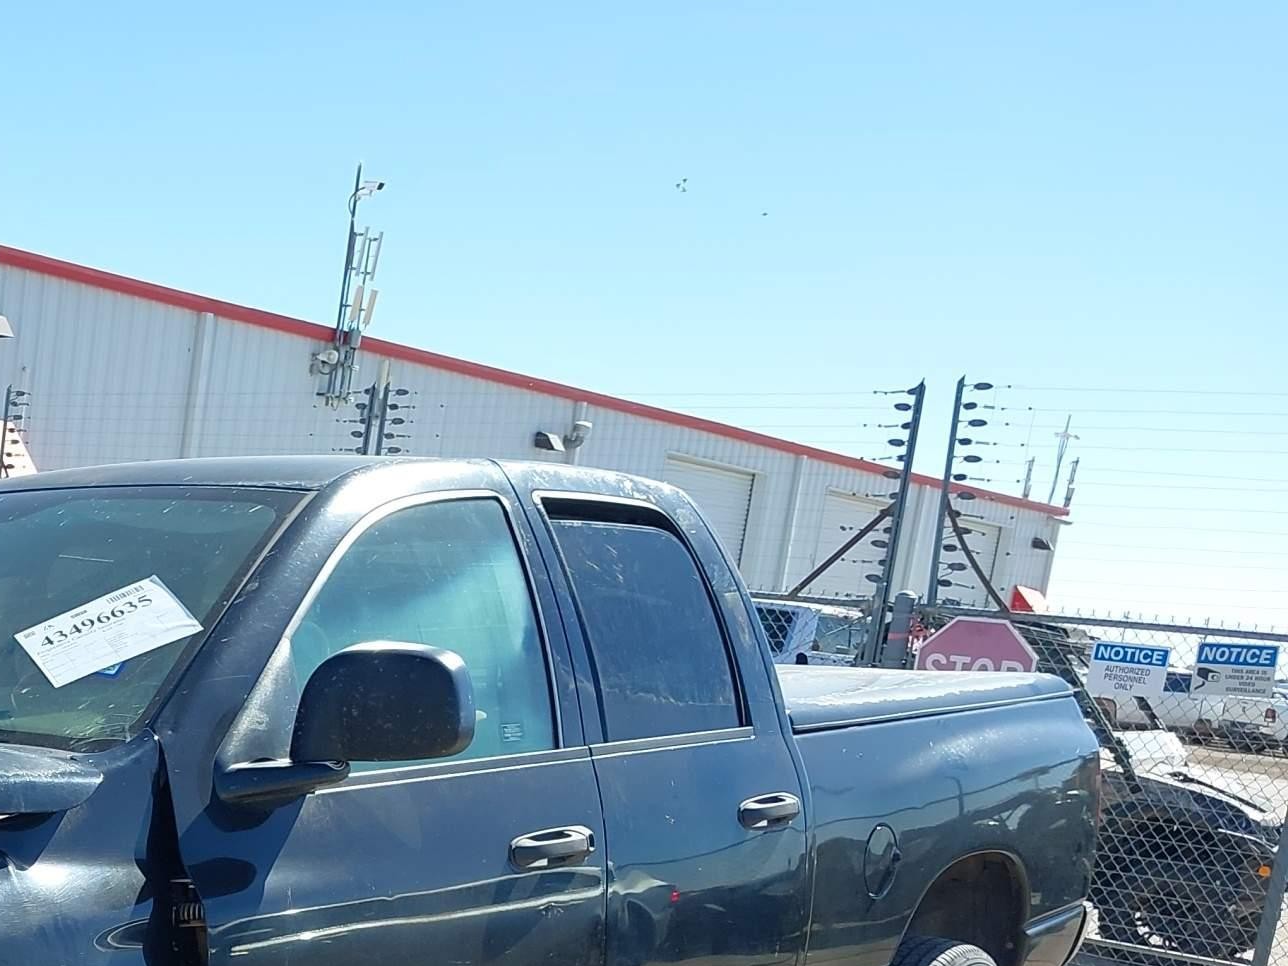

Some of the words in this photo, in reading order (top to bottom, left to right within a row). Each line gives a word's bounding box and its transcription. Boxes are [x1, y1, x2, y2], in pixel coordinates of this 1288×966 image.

[40, 594, 153, 647] 43496635
[1097, 645, 1165, 665] NOTICE
[1200, 646, 1275, 664] NOTICE
[1104, 664, 1151, 677] AUTHORIZED
[1103, 673, 1147, 685] PERSONNEL
[1113, 682, 1133, 692] ONLY
